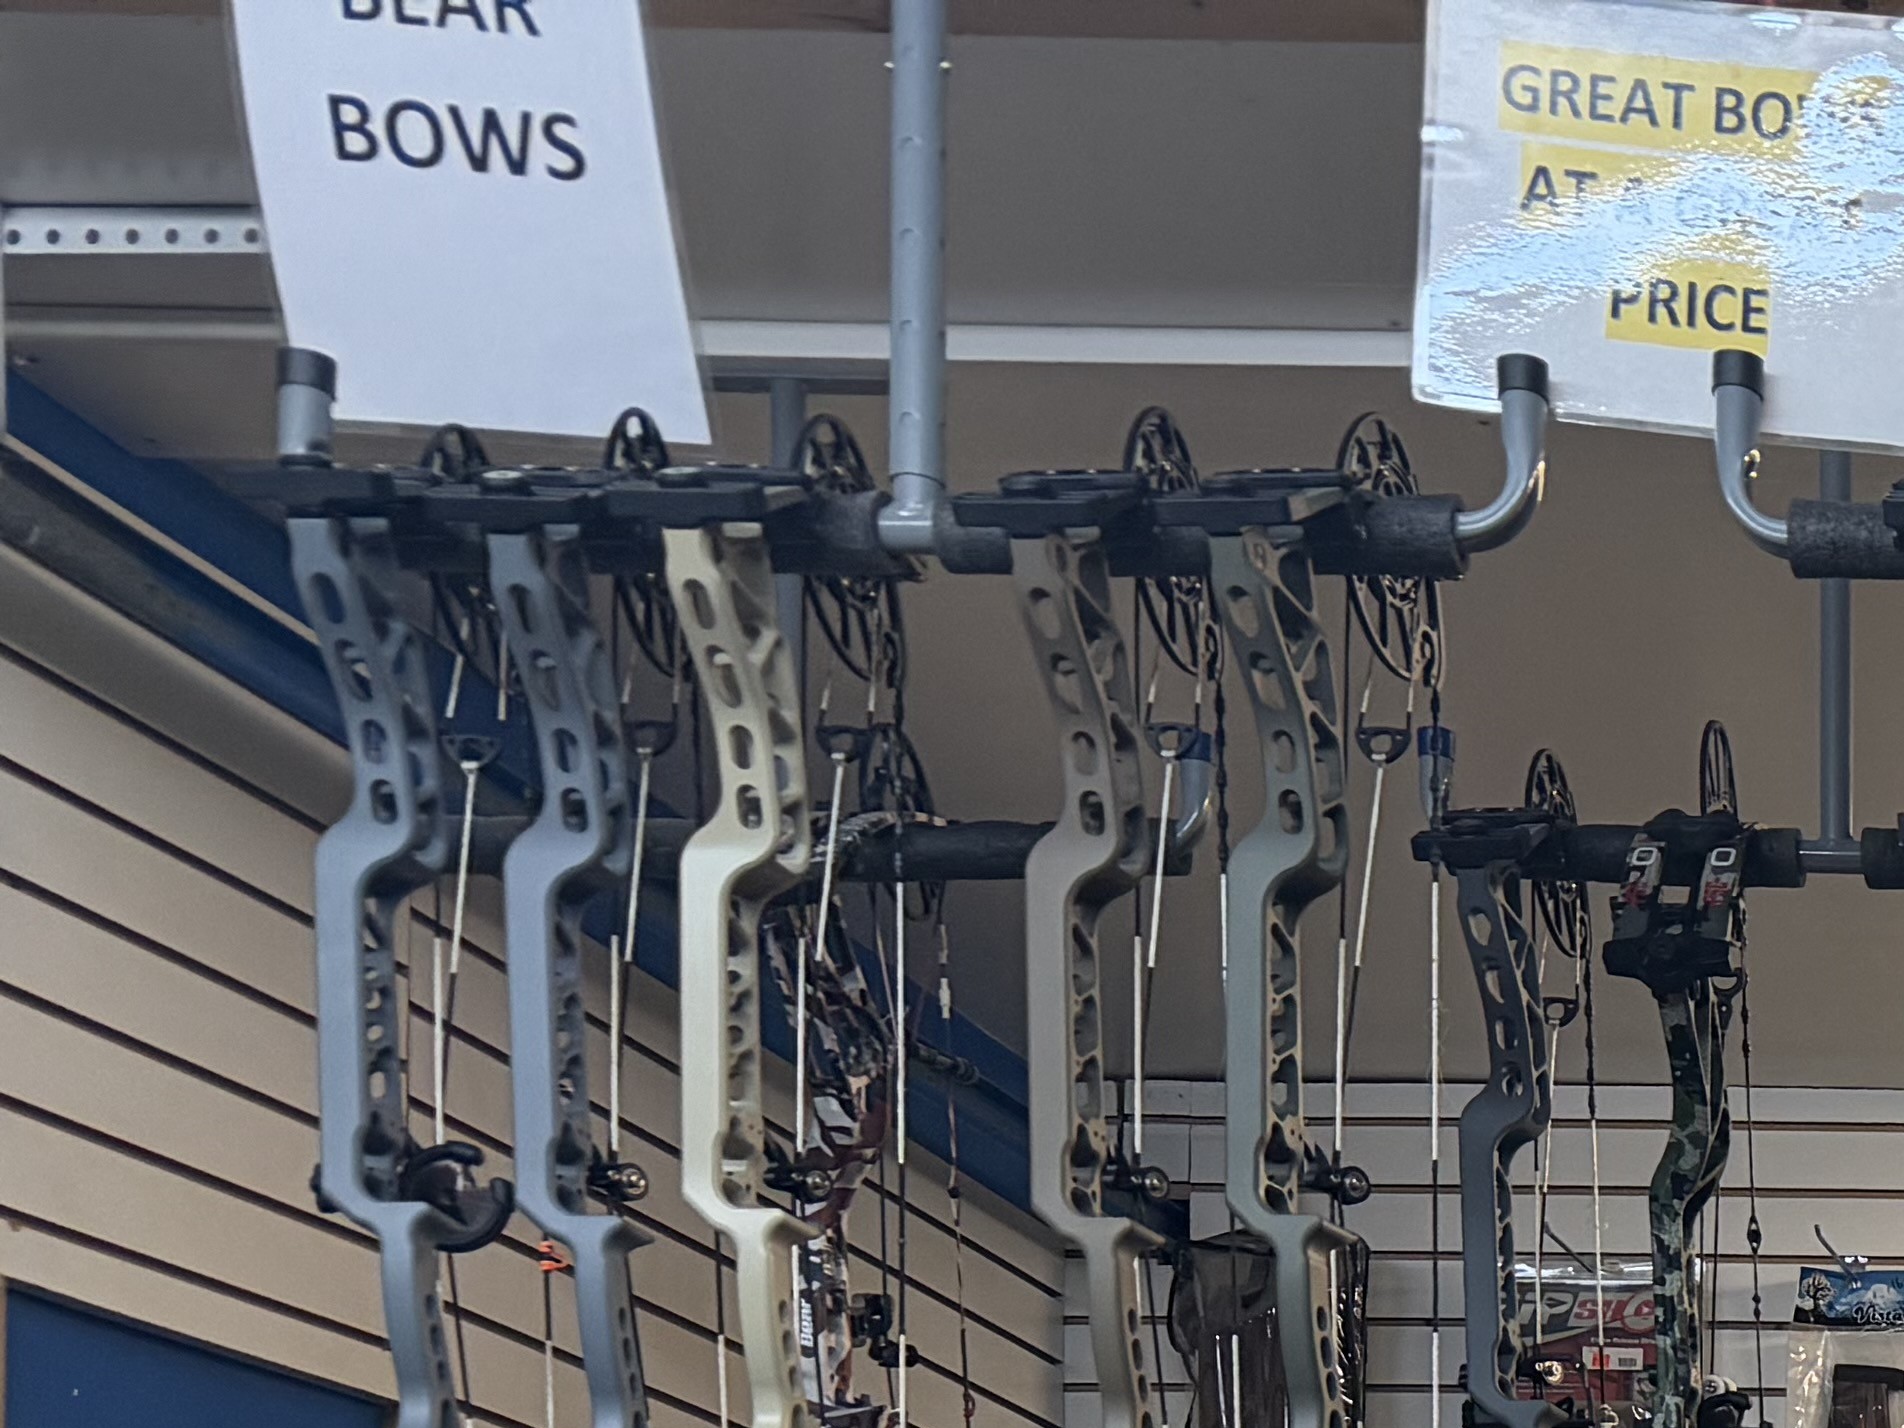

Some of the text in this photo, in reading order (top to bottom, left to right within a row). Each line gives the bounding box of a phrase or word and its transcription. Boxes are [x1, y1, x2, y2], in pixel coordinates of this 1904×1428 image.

[1502, 64, 1695, 131] GREAT
[327, 94, 586, 182] BOWS
[1610, 278, 1769, 336] PRICE
